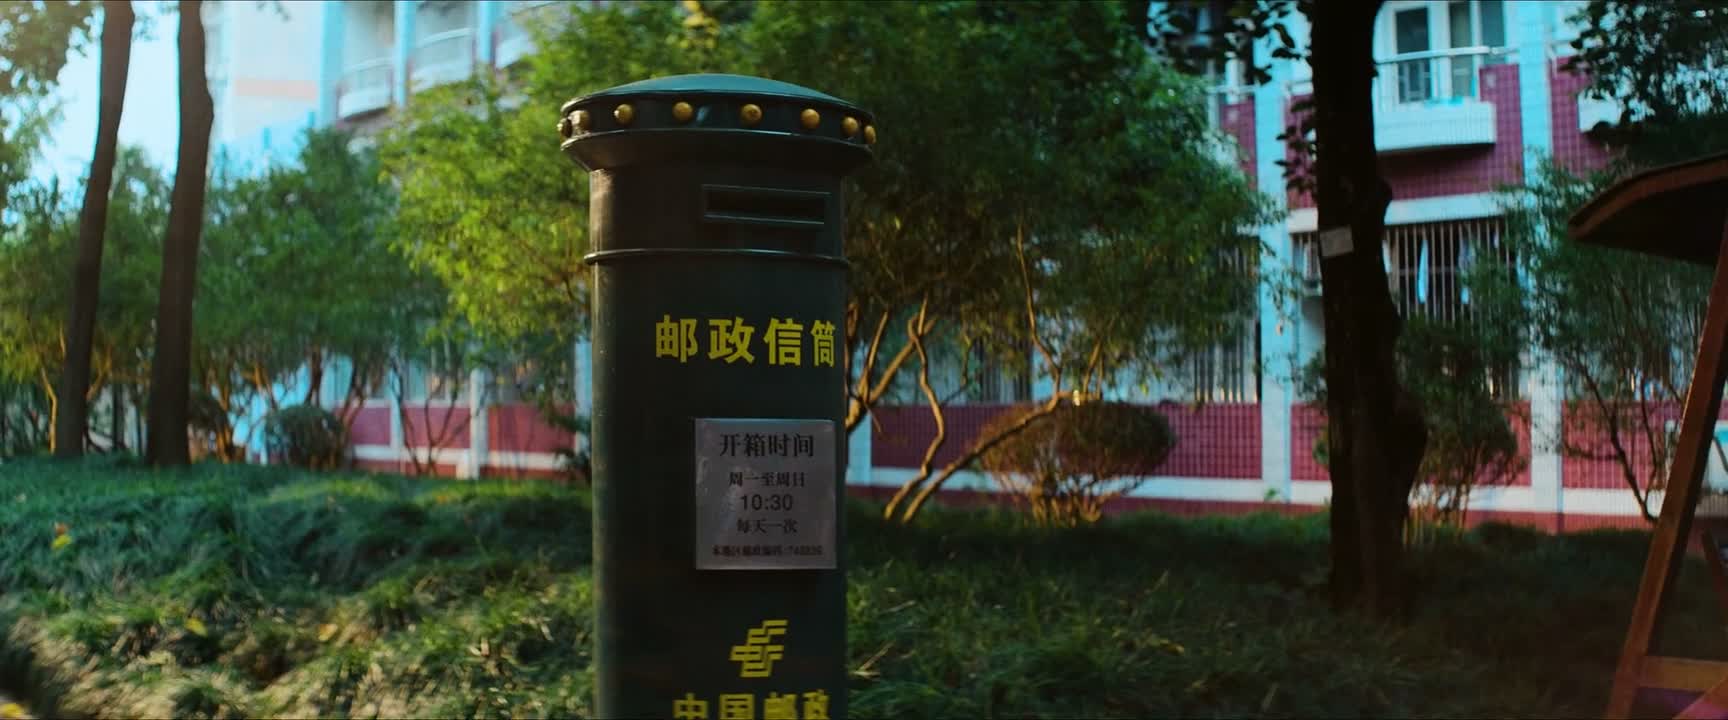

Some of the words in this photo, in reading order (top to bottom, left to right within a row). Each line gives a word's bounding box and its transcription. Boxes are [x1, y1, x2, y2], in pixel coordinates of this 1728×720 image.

[655, 314, 836, 367] 邮政信筒
[719, 432, 814, 457] 开箱时间
[728, 471, 805, 487] 周一至周日
[740, 494, 793, 511] 10:30
[736, 518, 798, 534] 每天一次
